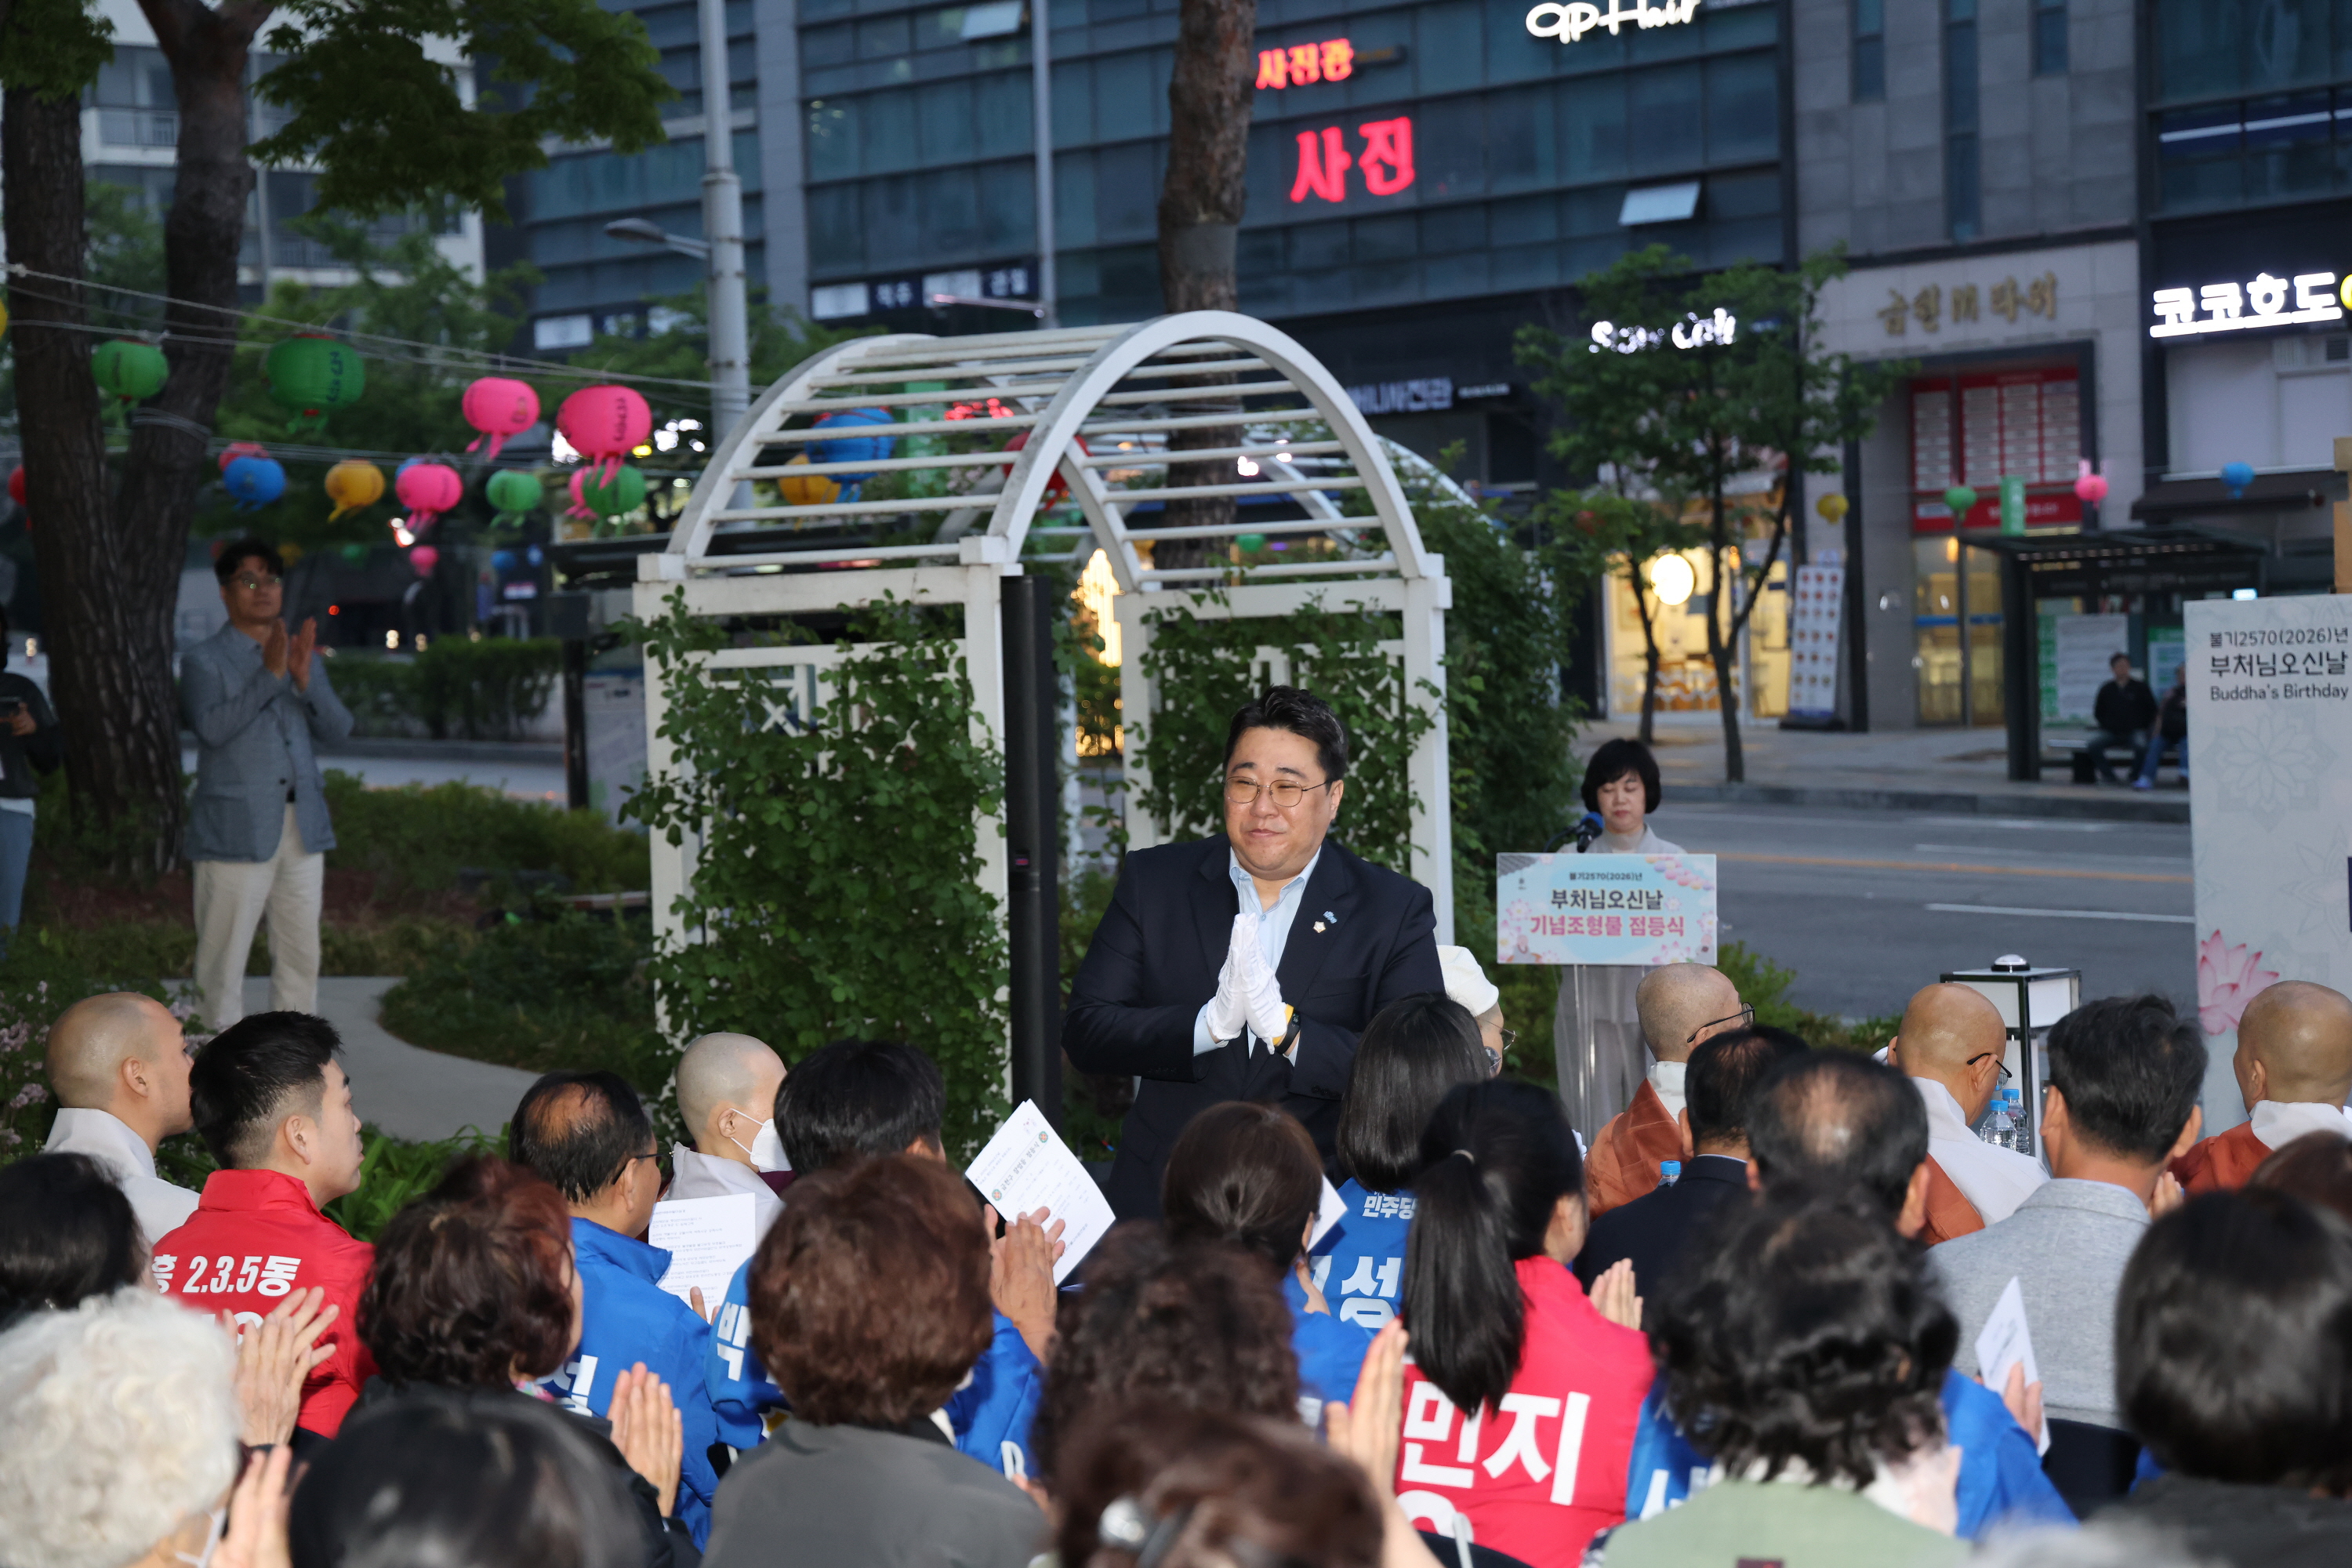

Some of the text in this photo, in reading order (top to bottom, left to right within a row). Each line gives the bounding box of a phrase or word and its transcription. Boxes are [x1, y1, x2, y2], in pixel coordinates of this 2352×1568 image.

[1256, 38, 1354, 89] 사진관
[1290, 116, 1415, 203] 사진
[2150, 272, 2343, 338] 코코호도
[2210, 650, 2349, 678] 부처님오신날
[2210, 682, 2349, 702] Buddha's Birthday
[1551, 888, 1664, 910] 부처님오신날
[1530, 915, 1685, 938] 기념조형물 점등식
[1362, 1196, 1417, 1220] 민주당
[1400, 1380, 1591, 1505] 민지
